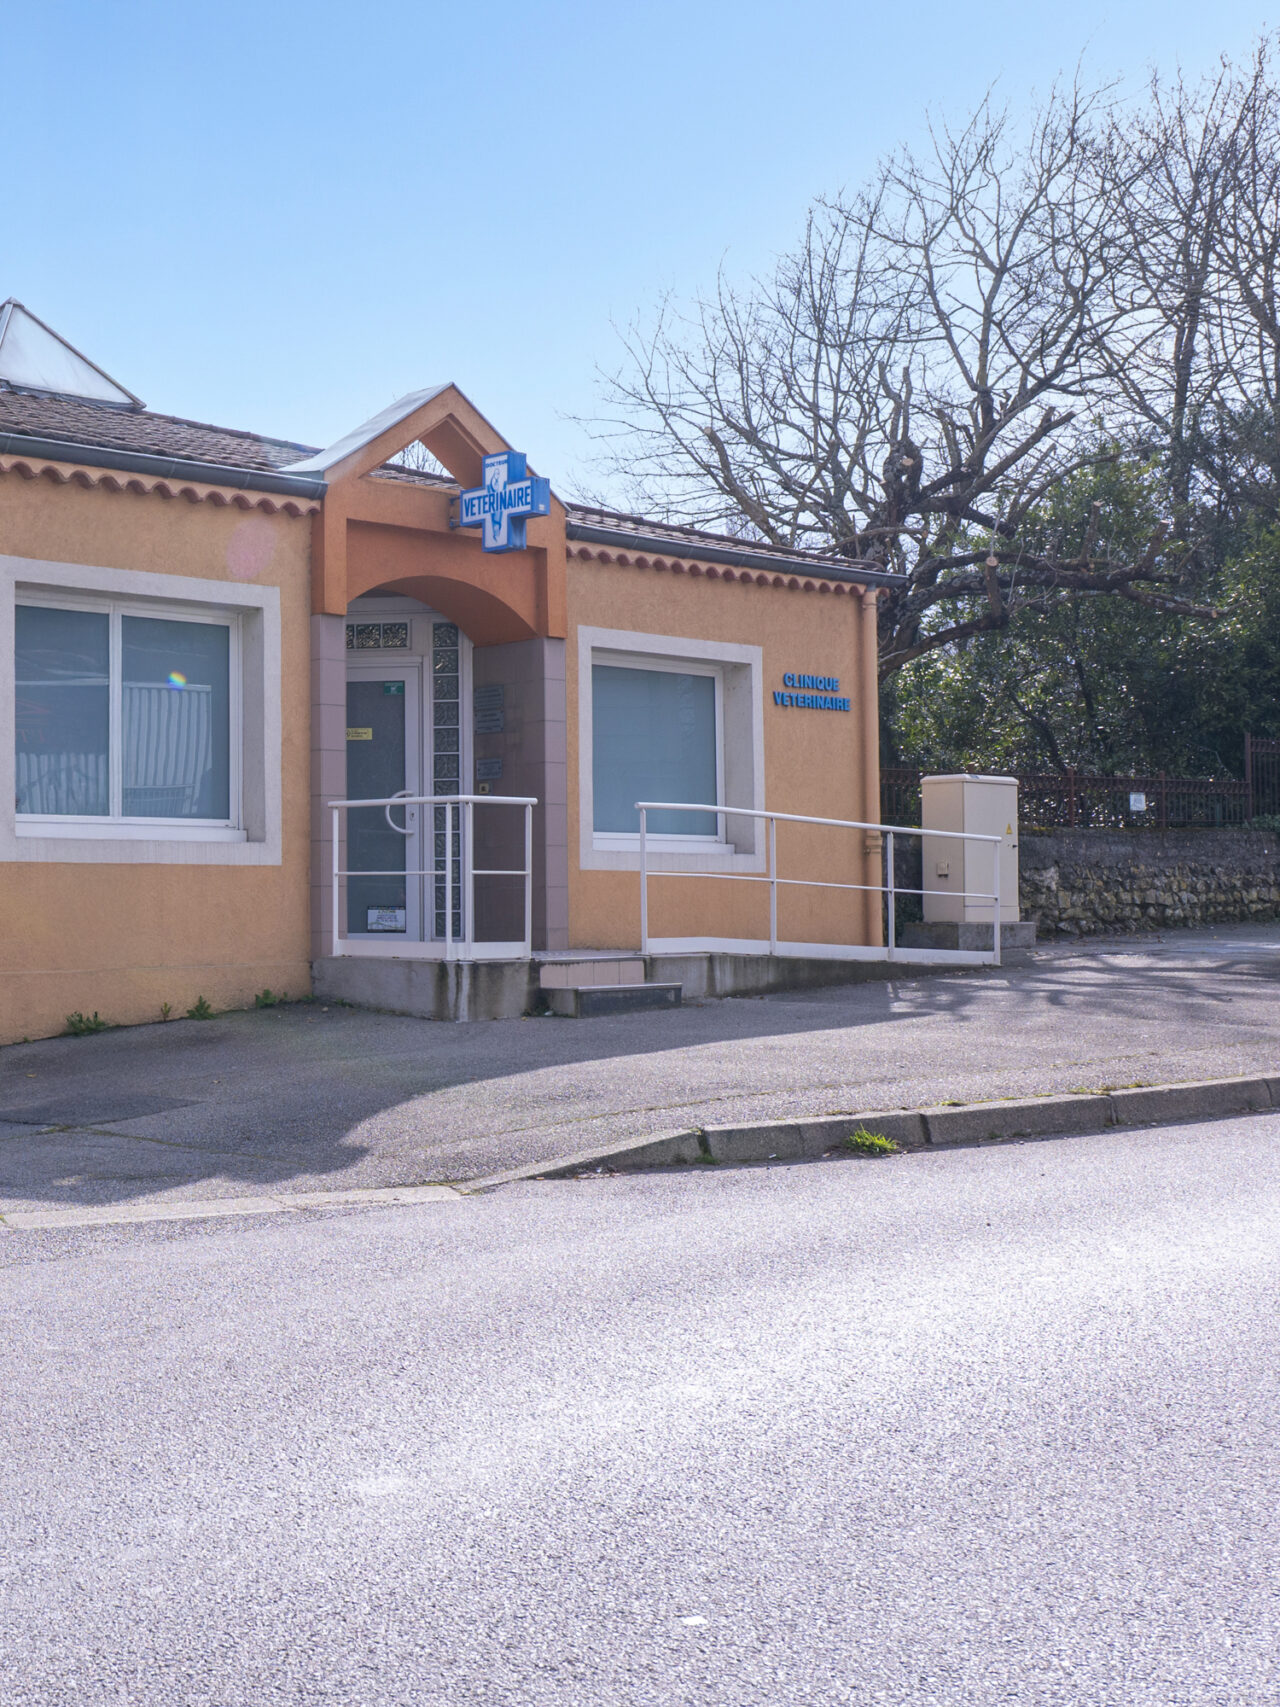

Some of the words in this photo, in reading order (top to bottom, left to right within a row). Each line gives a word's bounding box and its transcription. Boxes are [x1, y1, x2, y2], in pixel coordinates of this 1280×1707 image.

[464, 486, 531, 518] VETERINAIRE
[783, 672, 840, 692] CLINIQUE
[773, 691, 851, 712] VETERINAIRE
